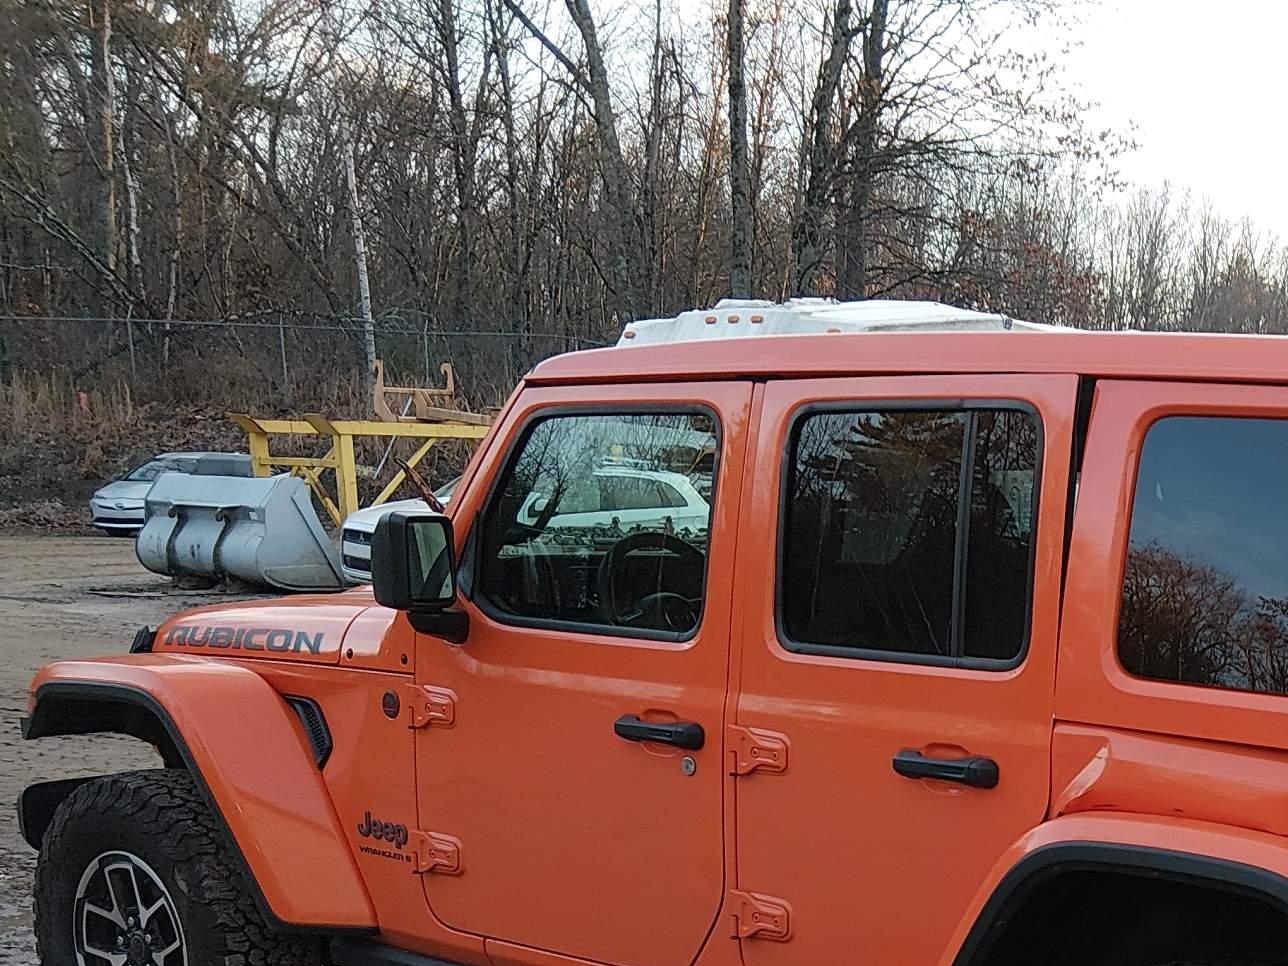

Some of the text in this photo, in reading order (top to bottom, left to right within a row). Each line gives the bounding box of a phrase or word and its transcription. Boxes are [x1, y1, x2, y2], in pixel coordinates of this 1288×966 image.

[165, 625, 324, 654] RUBICON
[357, 810, 408, 850] Jeep
[358, 844, 404, 861] WRANGLER
